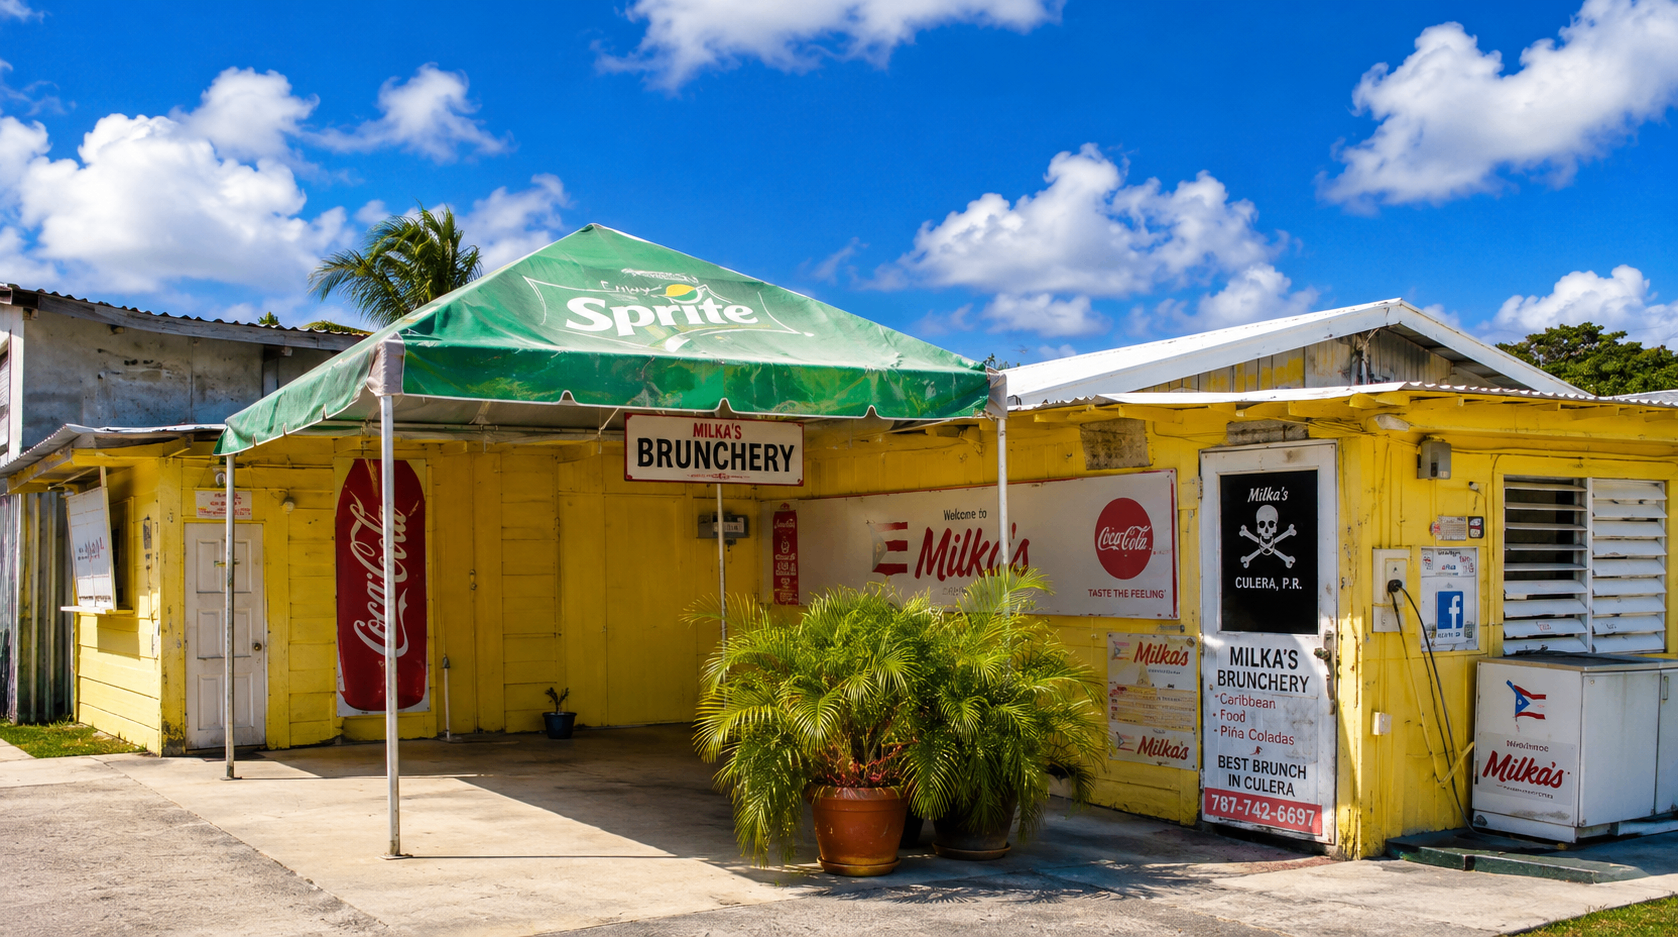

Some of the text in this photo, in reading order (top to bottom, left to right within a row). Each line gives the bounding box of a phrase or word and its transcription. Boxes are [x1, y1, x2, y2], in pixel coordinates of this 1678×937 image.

[566, 297, 759, 336] Sprite
[693, 423, 742, 440] MILKA'S
[637, 438, 795, 472] BRUNCHERY
[1247, 486, 1289, 503] Milka's
[943, 508, 987, 521] Welcome to
[1088, 588, 1112, 598] TASTE
[1113, 589, 1129, 598] THE
[1235, 576, 1303, 591] CULERA, P.R.
[1133, 641, 1189, 666] Milka's
[1229, 646, 1299, 670] MILKA'S
[1217, 669, 1310, 693] BRUNCHERY
[1220, 692, 1276, 709] Caribbean
[1220, 709, 1246, 723] Food
[1137, 735, 1190, 760] Milka's
[1248, 728, 1295, 746] Coladas
[1217, 754, 1307, 780] BEST BRUNCH
[1482, 750, 1565, 788] Milka's
[1228, 773, 1296, 797] IN CULERA
[1211, 794, 1316, 827] 787-742-6697
